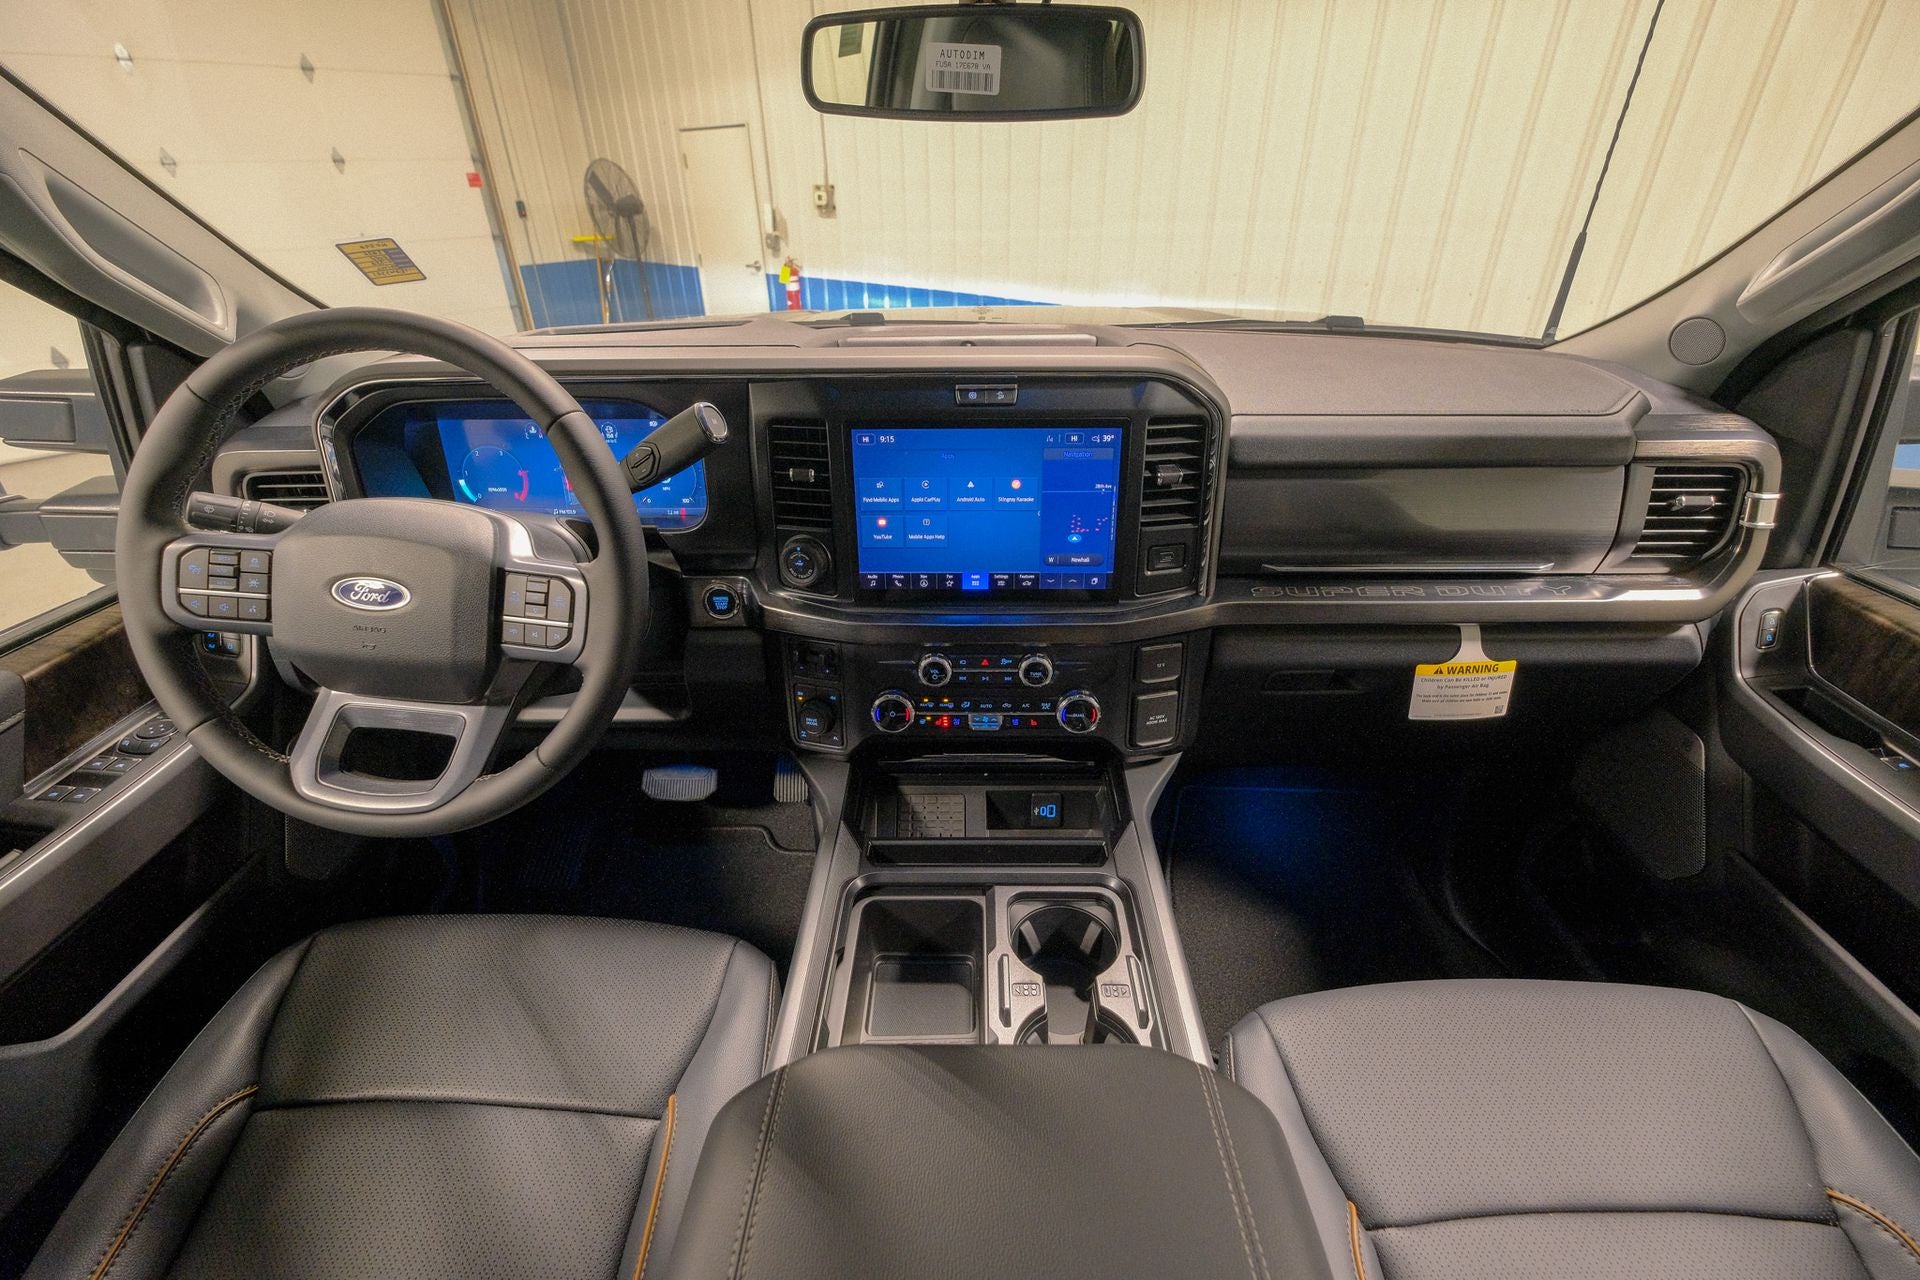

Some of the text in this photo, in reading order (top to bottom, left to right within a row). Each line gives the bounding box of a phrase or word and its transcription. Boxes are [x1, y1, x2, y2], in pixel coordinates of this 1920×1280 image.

[940, 49, 984, 60] AUTODIM
[879, 435, 895, 443] 9:15
[1063, 451, 1093, 459] Navigation
[350, 580, 392, 603] Ford
[1250, 585, 1572, 597] SUPER DUTY
[1447, 663, 1499, 675] WARNING
